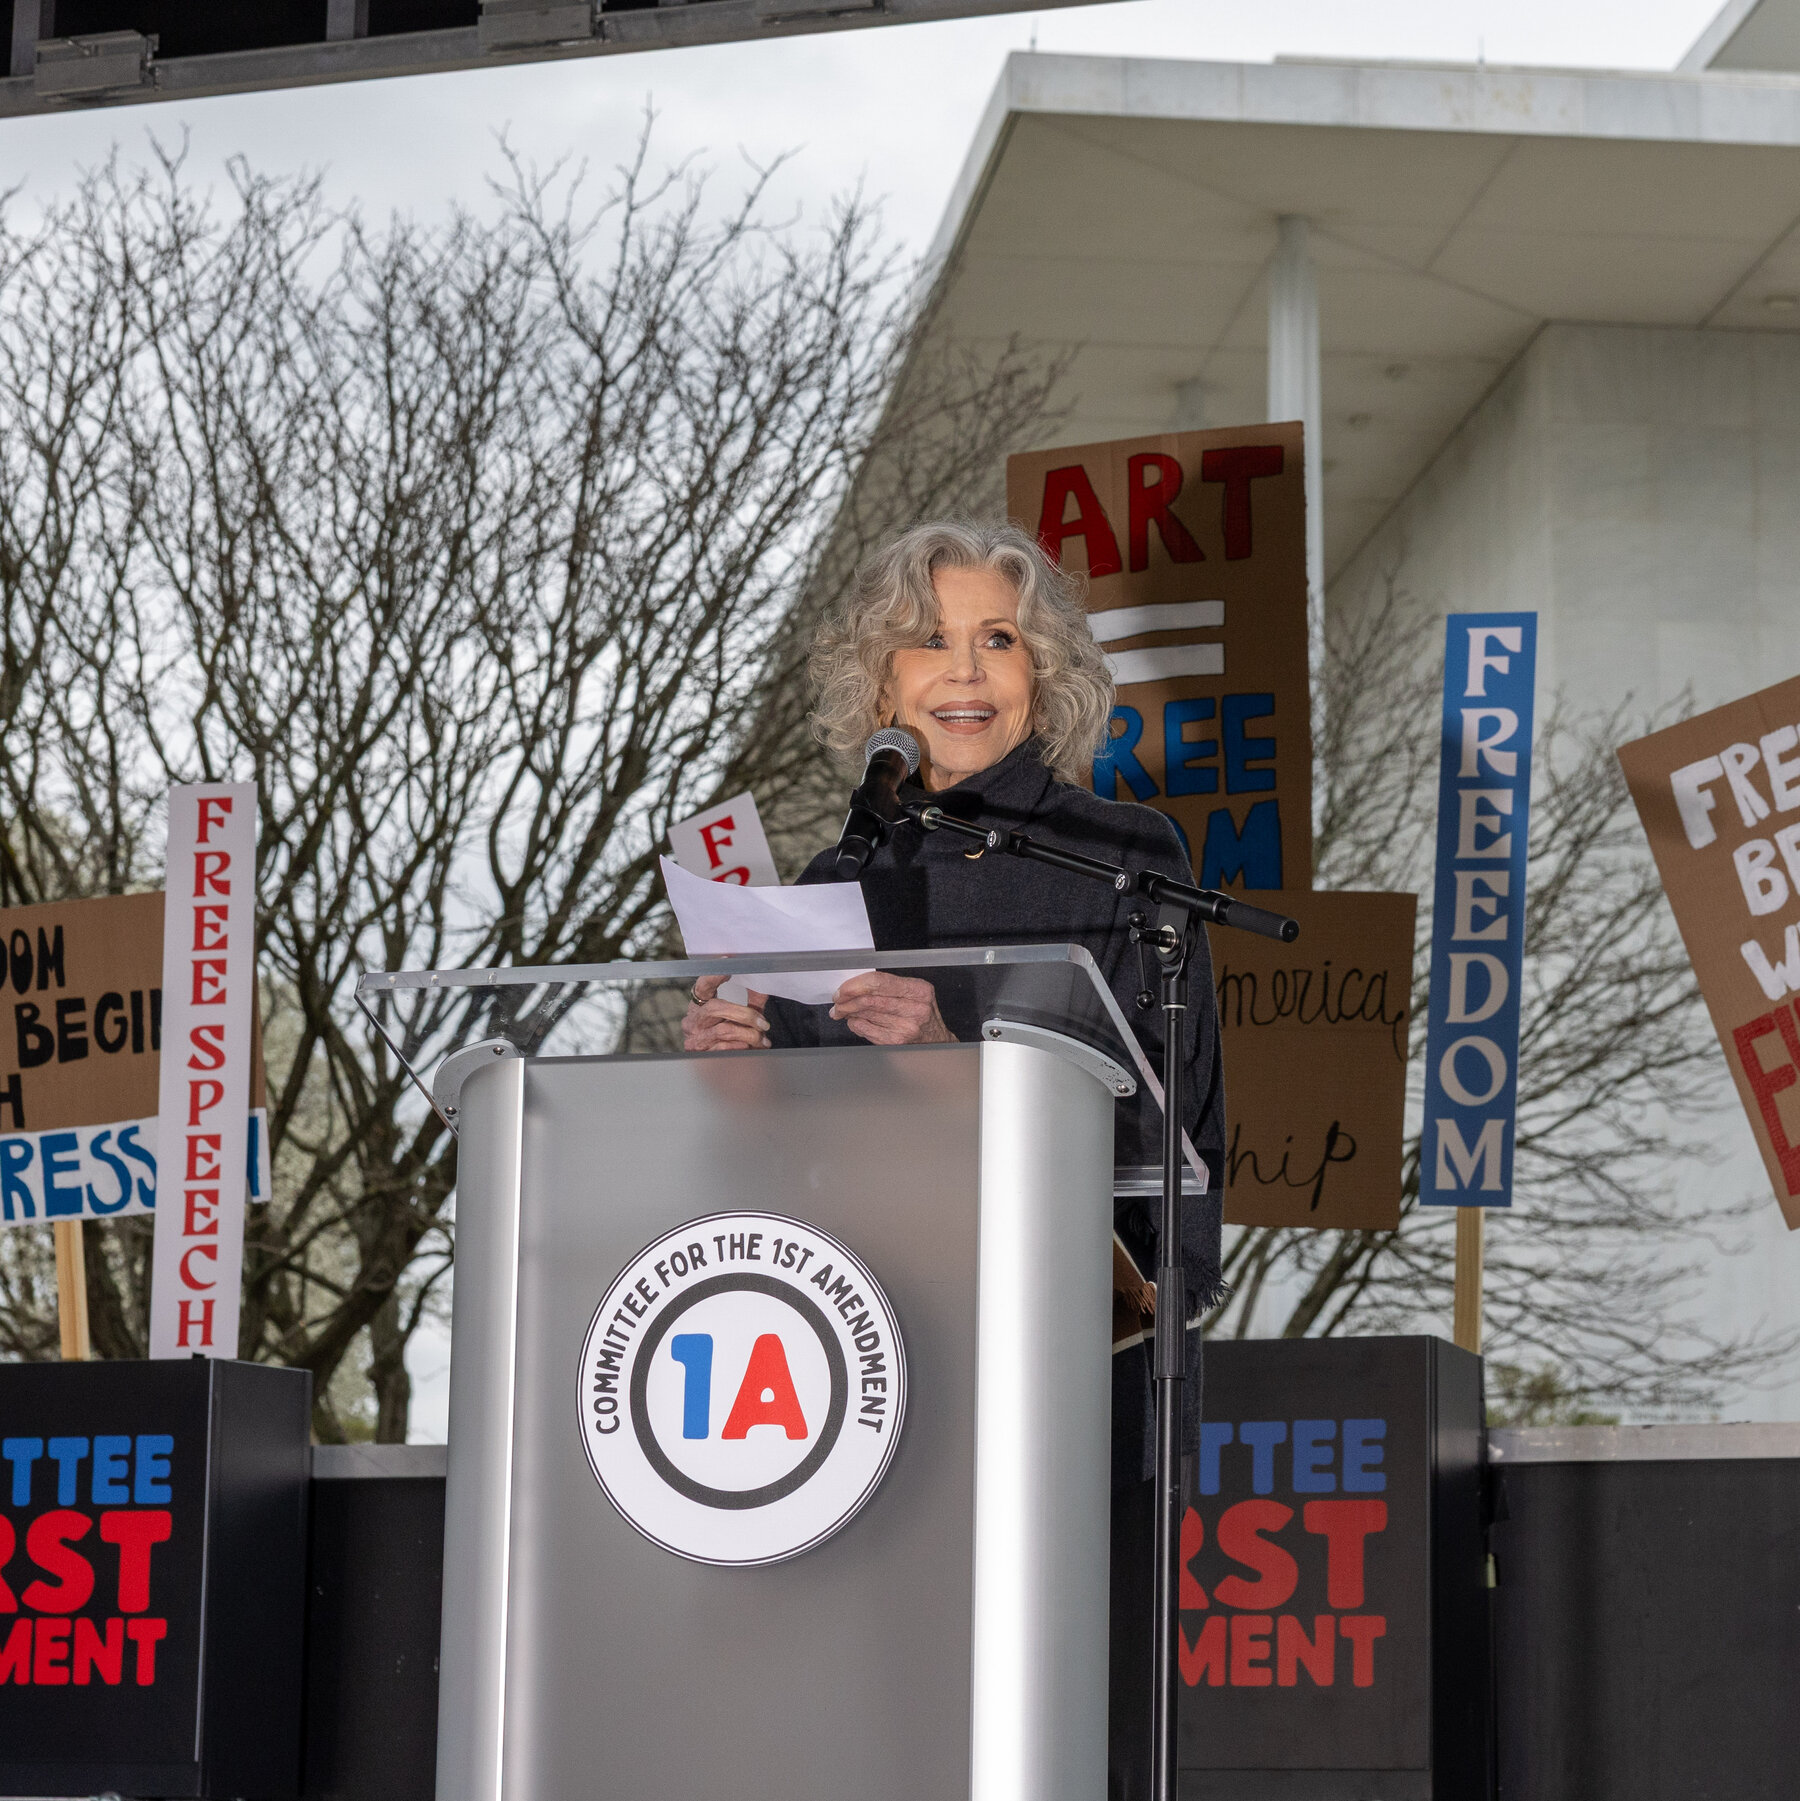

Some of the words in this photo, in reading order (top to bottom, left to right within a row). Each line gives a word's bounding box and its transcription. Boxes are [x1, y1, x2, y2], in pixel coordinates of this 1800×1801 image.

[1038, 446, 1284, 578] ART
[1093, 693, 1276, 802] REE
[1670, 723, 1800, 850] FRE
[1163, 799, 1283, 891] M
[189, 797, 233, 1005] FREE
[1435, 626, 1523, 1191] FREEDOM
[1740, 920, 1800, 1000] W
[175, 1025, 227, 1347] SPEECH
[1226, 1119, 1357, 1212] hip
[593, 1277, 660, 1435] COMMITTEE
[654, 1242, 708, 1287] FOR
[712, 1233, 763, 1262] THE
[772, 1238, 815, 1273] 1ST
[810, 1263, 888, 1434] AMENDMENT
[670, 1333, 809, 1440] 1A
[2, 1434, 174, 1507] TTEE
[1199, 1418, 1387, 1495] TTEE
[0, 1510, 173, 1615] ST
